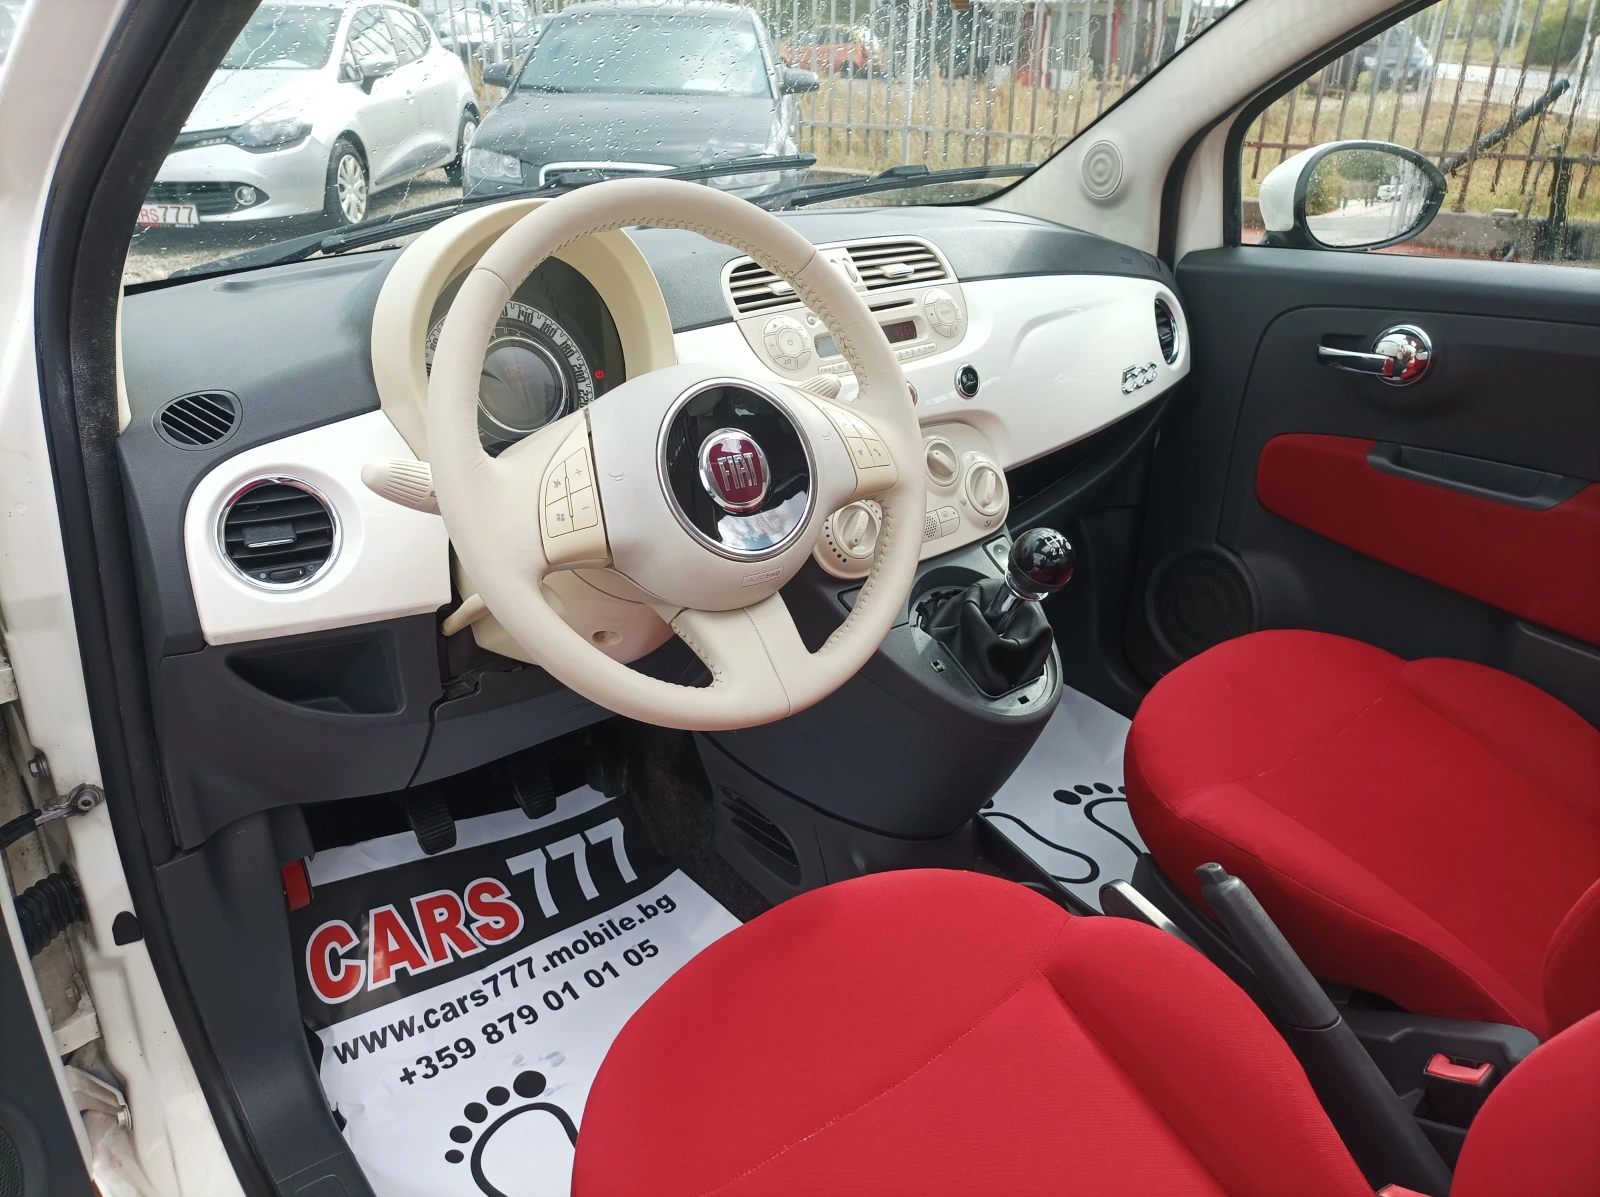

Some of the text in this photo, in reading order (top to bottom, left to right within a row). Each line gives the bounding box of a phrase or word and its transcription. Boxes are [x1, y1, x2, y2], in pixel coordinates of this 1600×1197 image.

[137, 206, 194, 222] RS777
[517, 308, 534, 324] 140
[541, 321, 558, 339] 160
[560, 340, 576, 359] 180
[572, 363, 587, 384] 200
[1121, 362, 1158, 395] 500
[717, 452, 758, 492] FIAT
[332, 893, 677, 1065] www.cars777.mobile.bg
[399, 938, 660, 1086] +359 879 01 01 05
